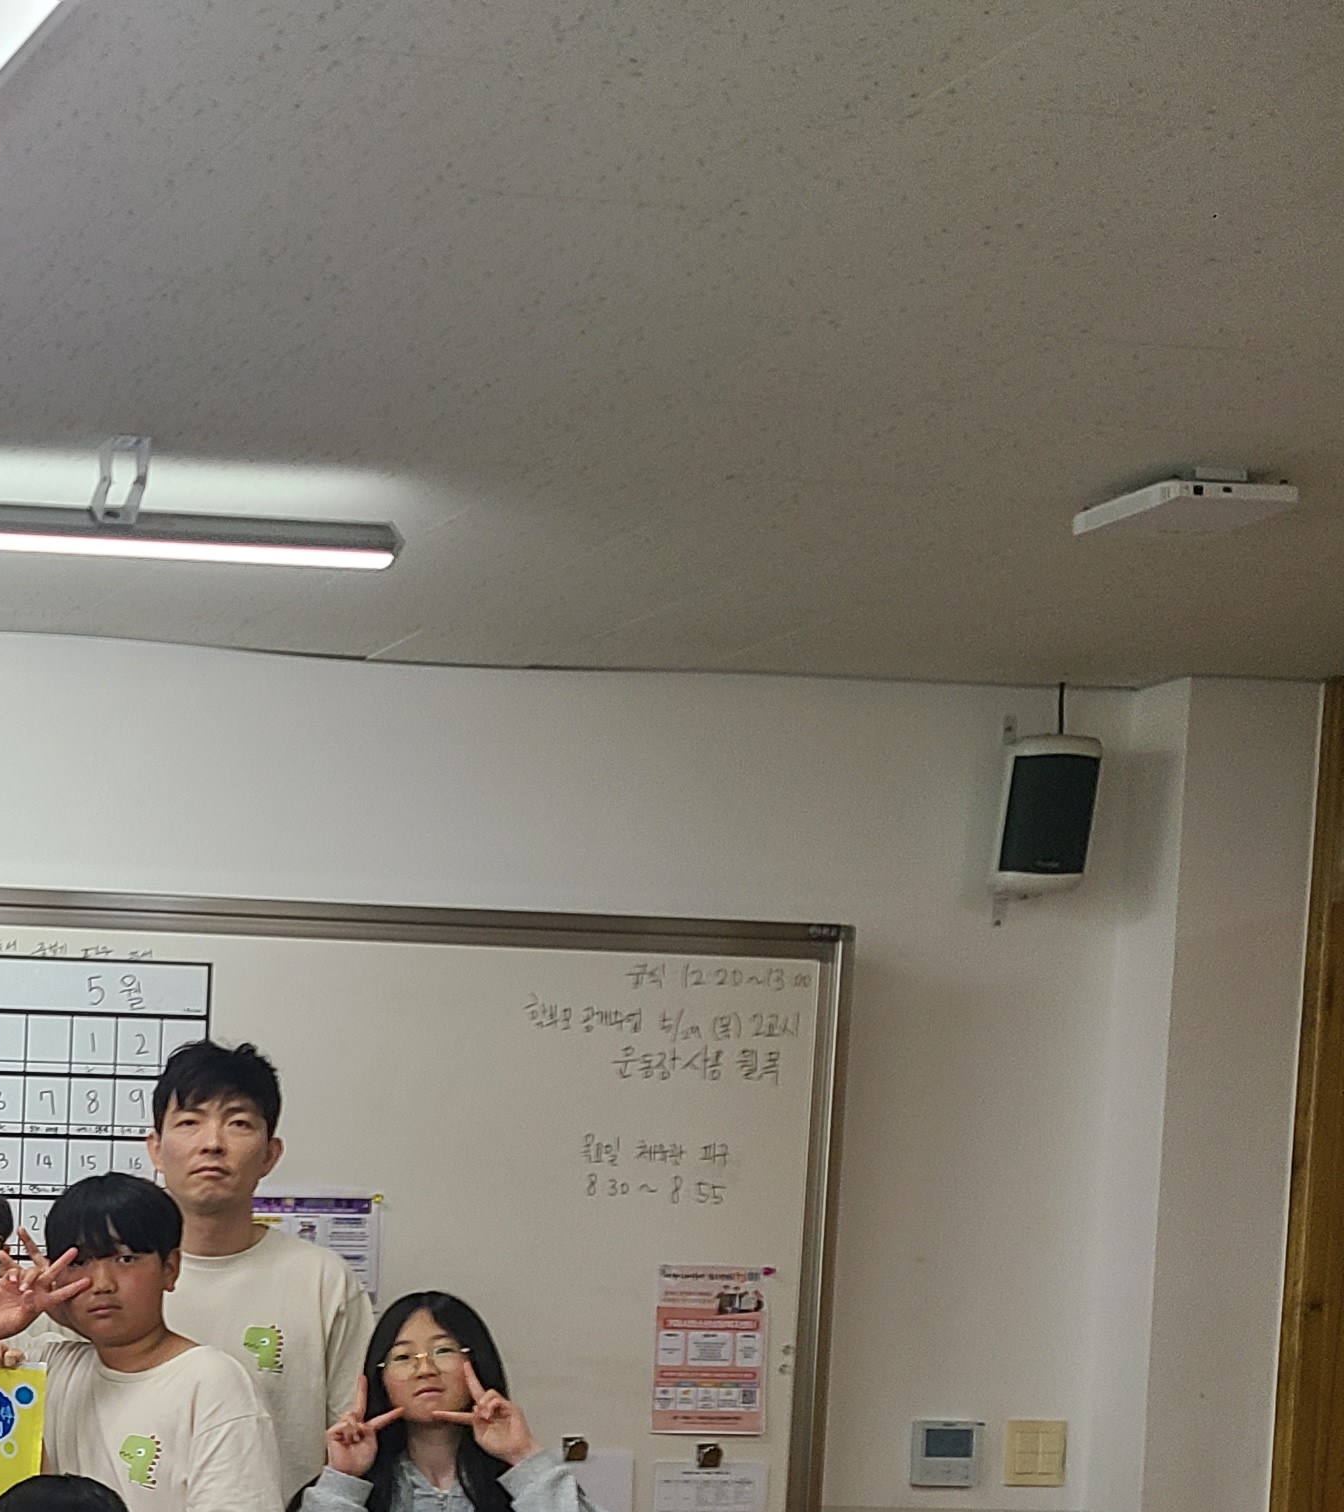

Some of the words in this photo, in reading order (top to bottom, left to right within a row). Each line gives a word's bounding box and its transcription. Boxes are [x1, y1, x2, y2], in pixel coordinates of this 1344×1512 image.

[119, 973, 146, 1011] 월
[134, 1033, 150, 1055] 2
[39, 1089, 56, 1116] 7
[85, 1089, 100, 1114] 8
[129, 1088, 146, 1120] 9
[36, 1152, 53, 1169] 14
[80, 1154, 97, 1171] 15
[128, 1156, 142, 1170] 16
